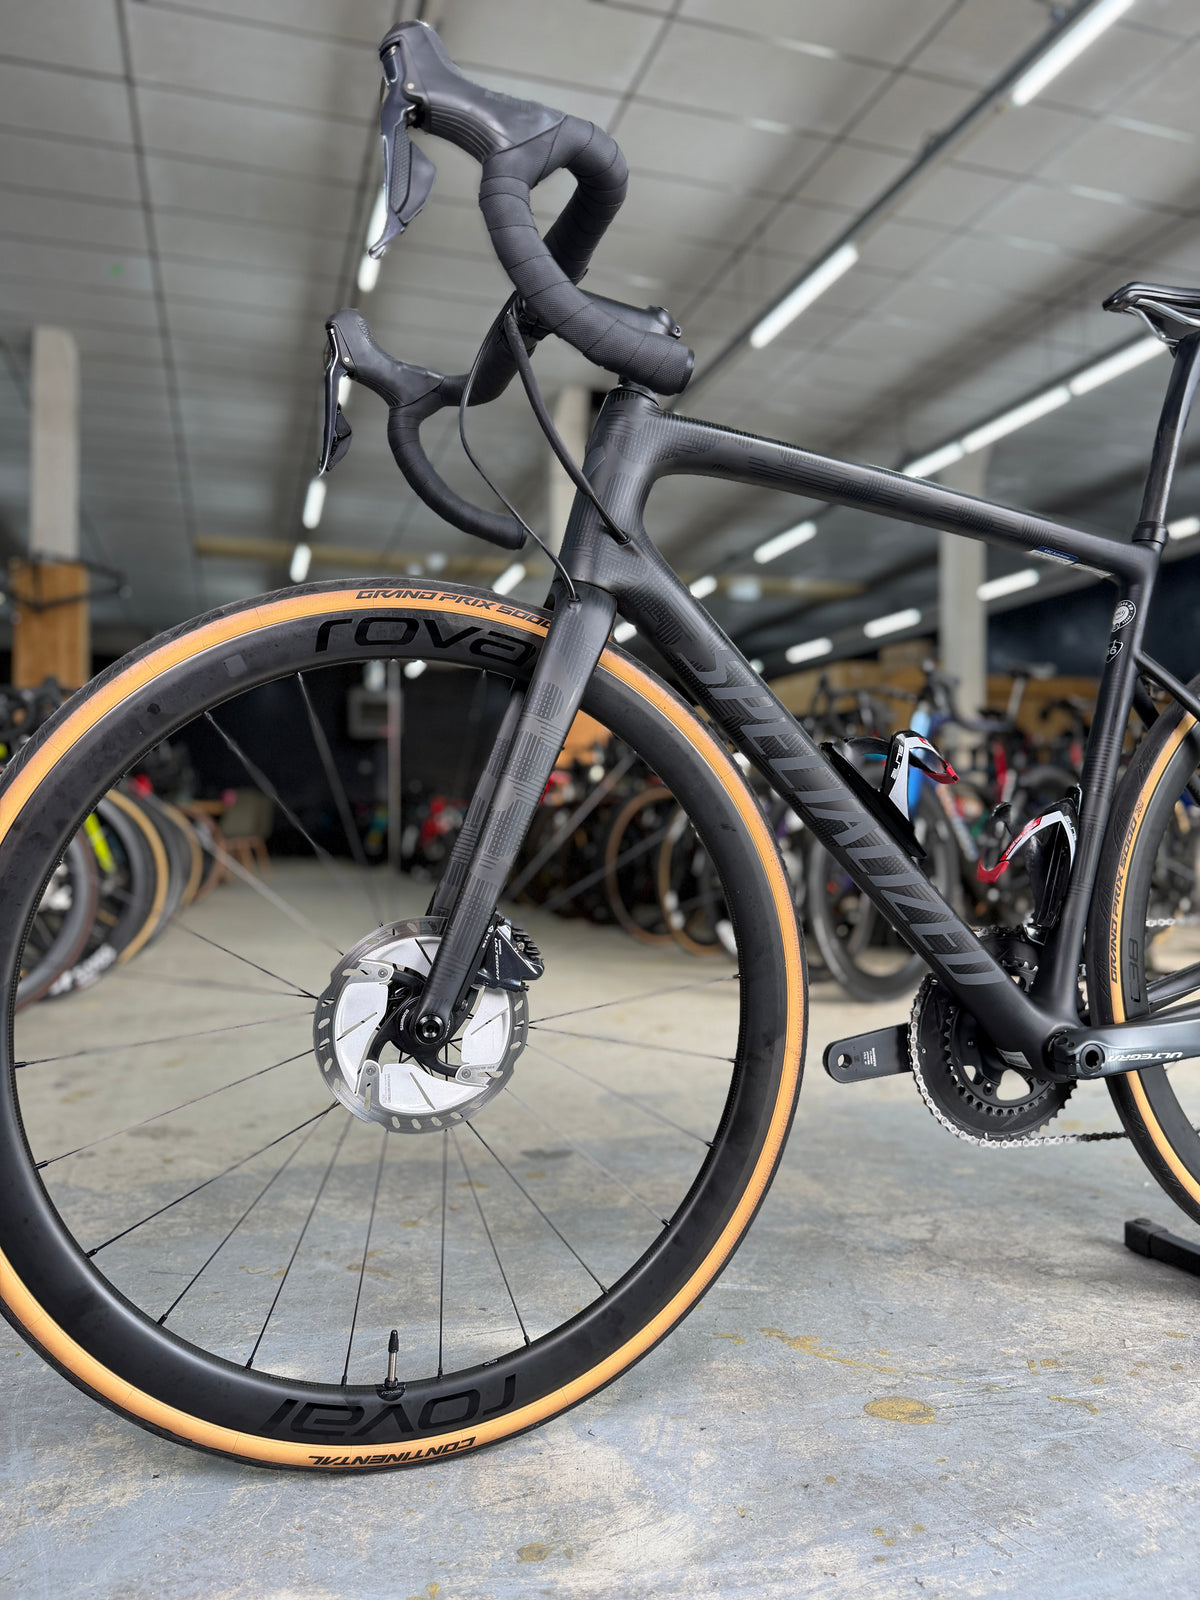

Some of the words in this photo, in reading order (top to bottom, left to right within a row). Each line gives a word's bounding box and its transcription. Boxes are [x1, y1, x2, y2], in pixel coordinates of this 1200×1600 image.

[356, 590, 438, 600] GRAND
[439, 593, 495, 610] PRIX
[315, 616, 538, 670] rova
[677, 649, 1007, 986] SPECIALIZED
[1119, 817, 1137, 871] 5000
[1112, 870, 1124, 918] PRIX
[1109, 919, 1118, 984] GRAND
[1107, 1051, 1183, 1062] ULTEGRA
[259, 1373, 517, 1437] roval
[308, 1436, 476, 1467] CONTINENTAL
